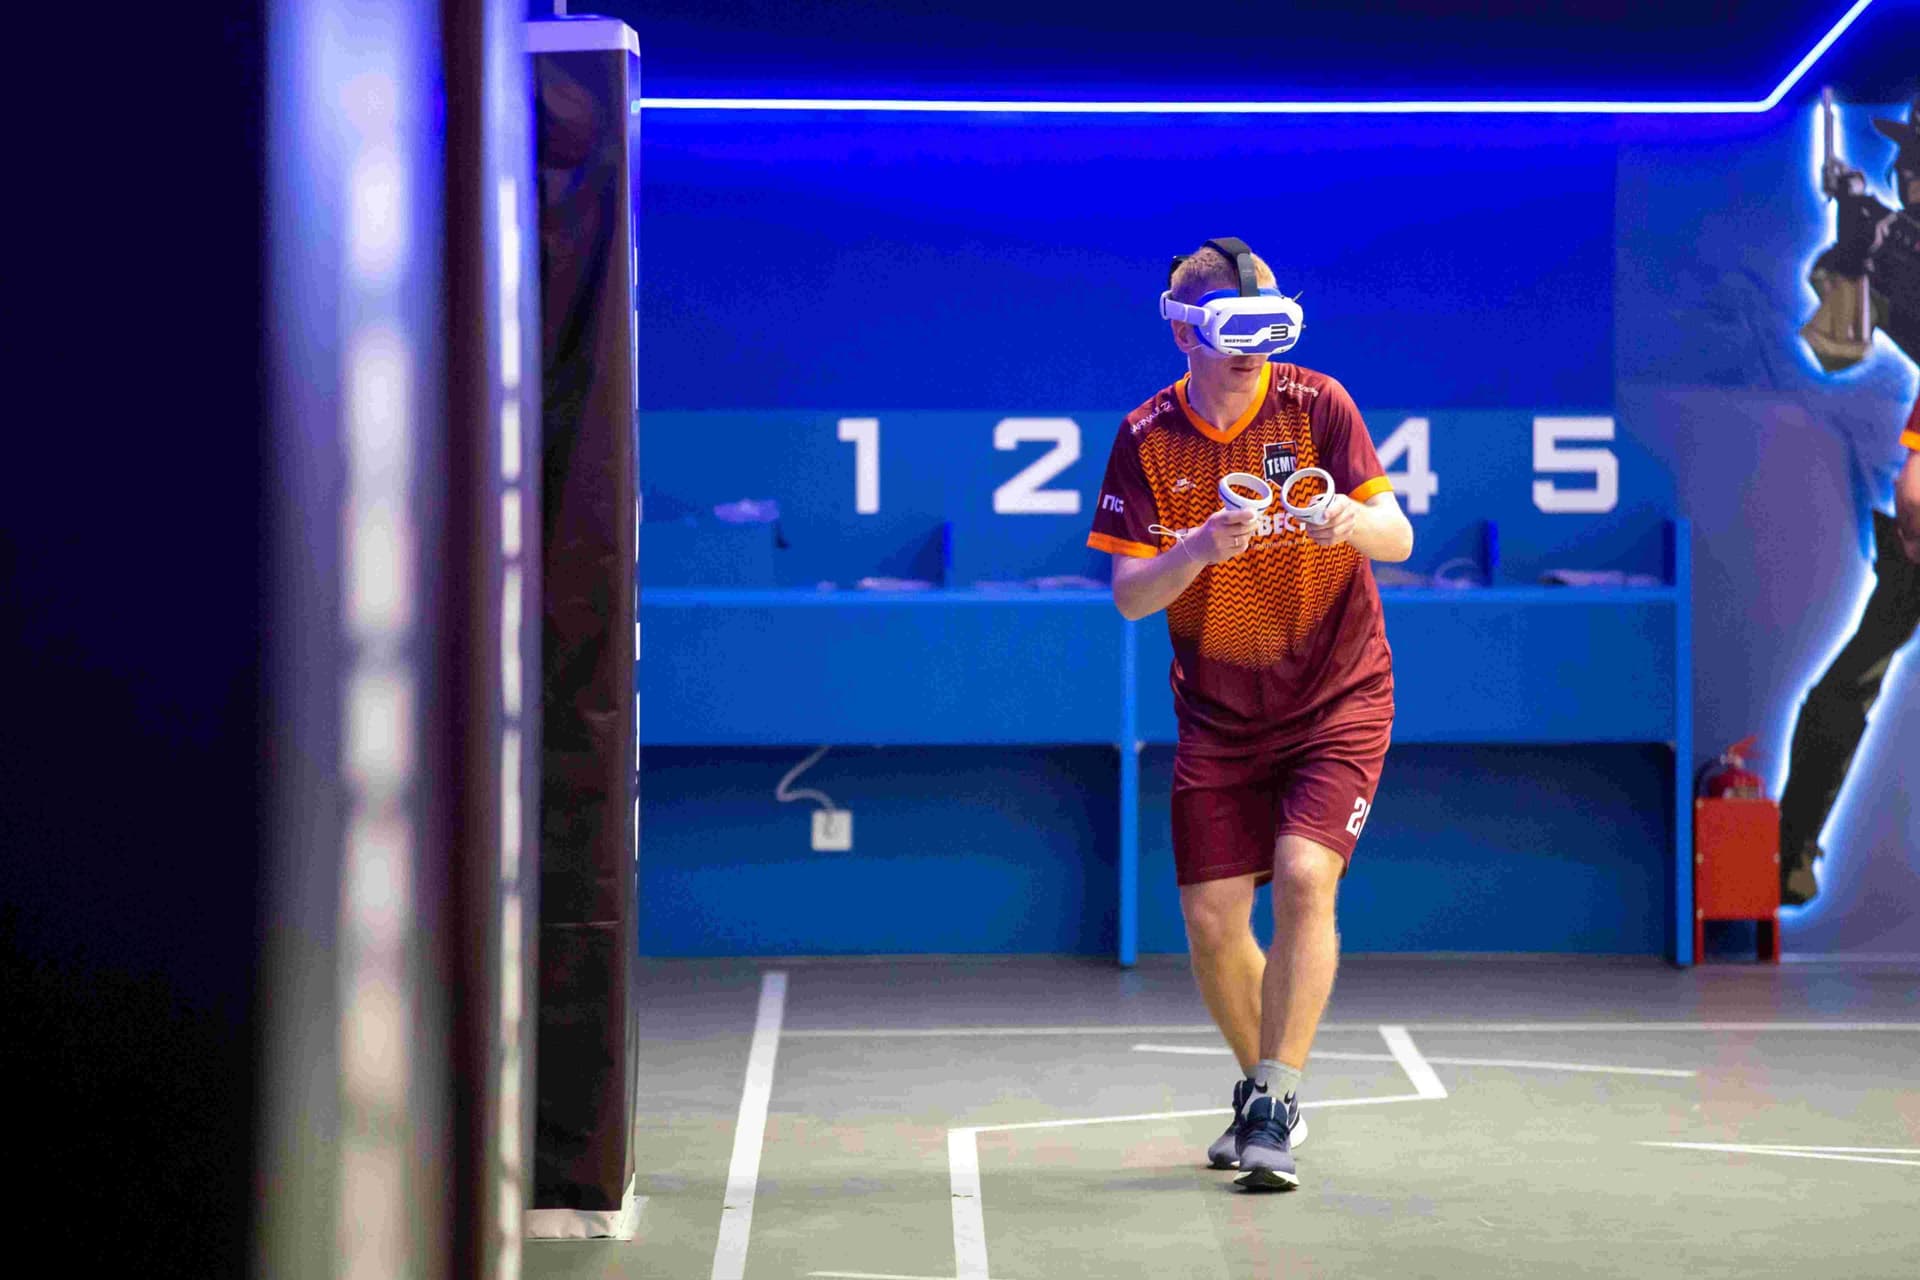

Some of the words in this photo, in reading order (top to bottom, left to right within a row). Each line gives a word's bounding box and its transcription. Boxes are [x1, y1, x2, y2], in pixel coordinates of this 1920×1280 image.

[1271, 325, 1288, 340] 3
[837, 417, 880, 514] 1
[992, 417, 1082, 514] 2
[1376, 417, 1439, 514] 4
[1532, 416, 1619, 514] 5
